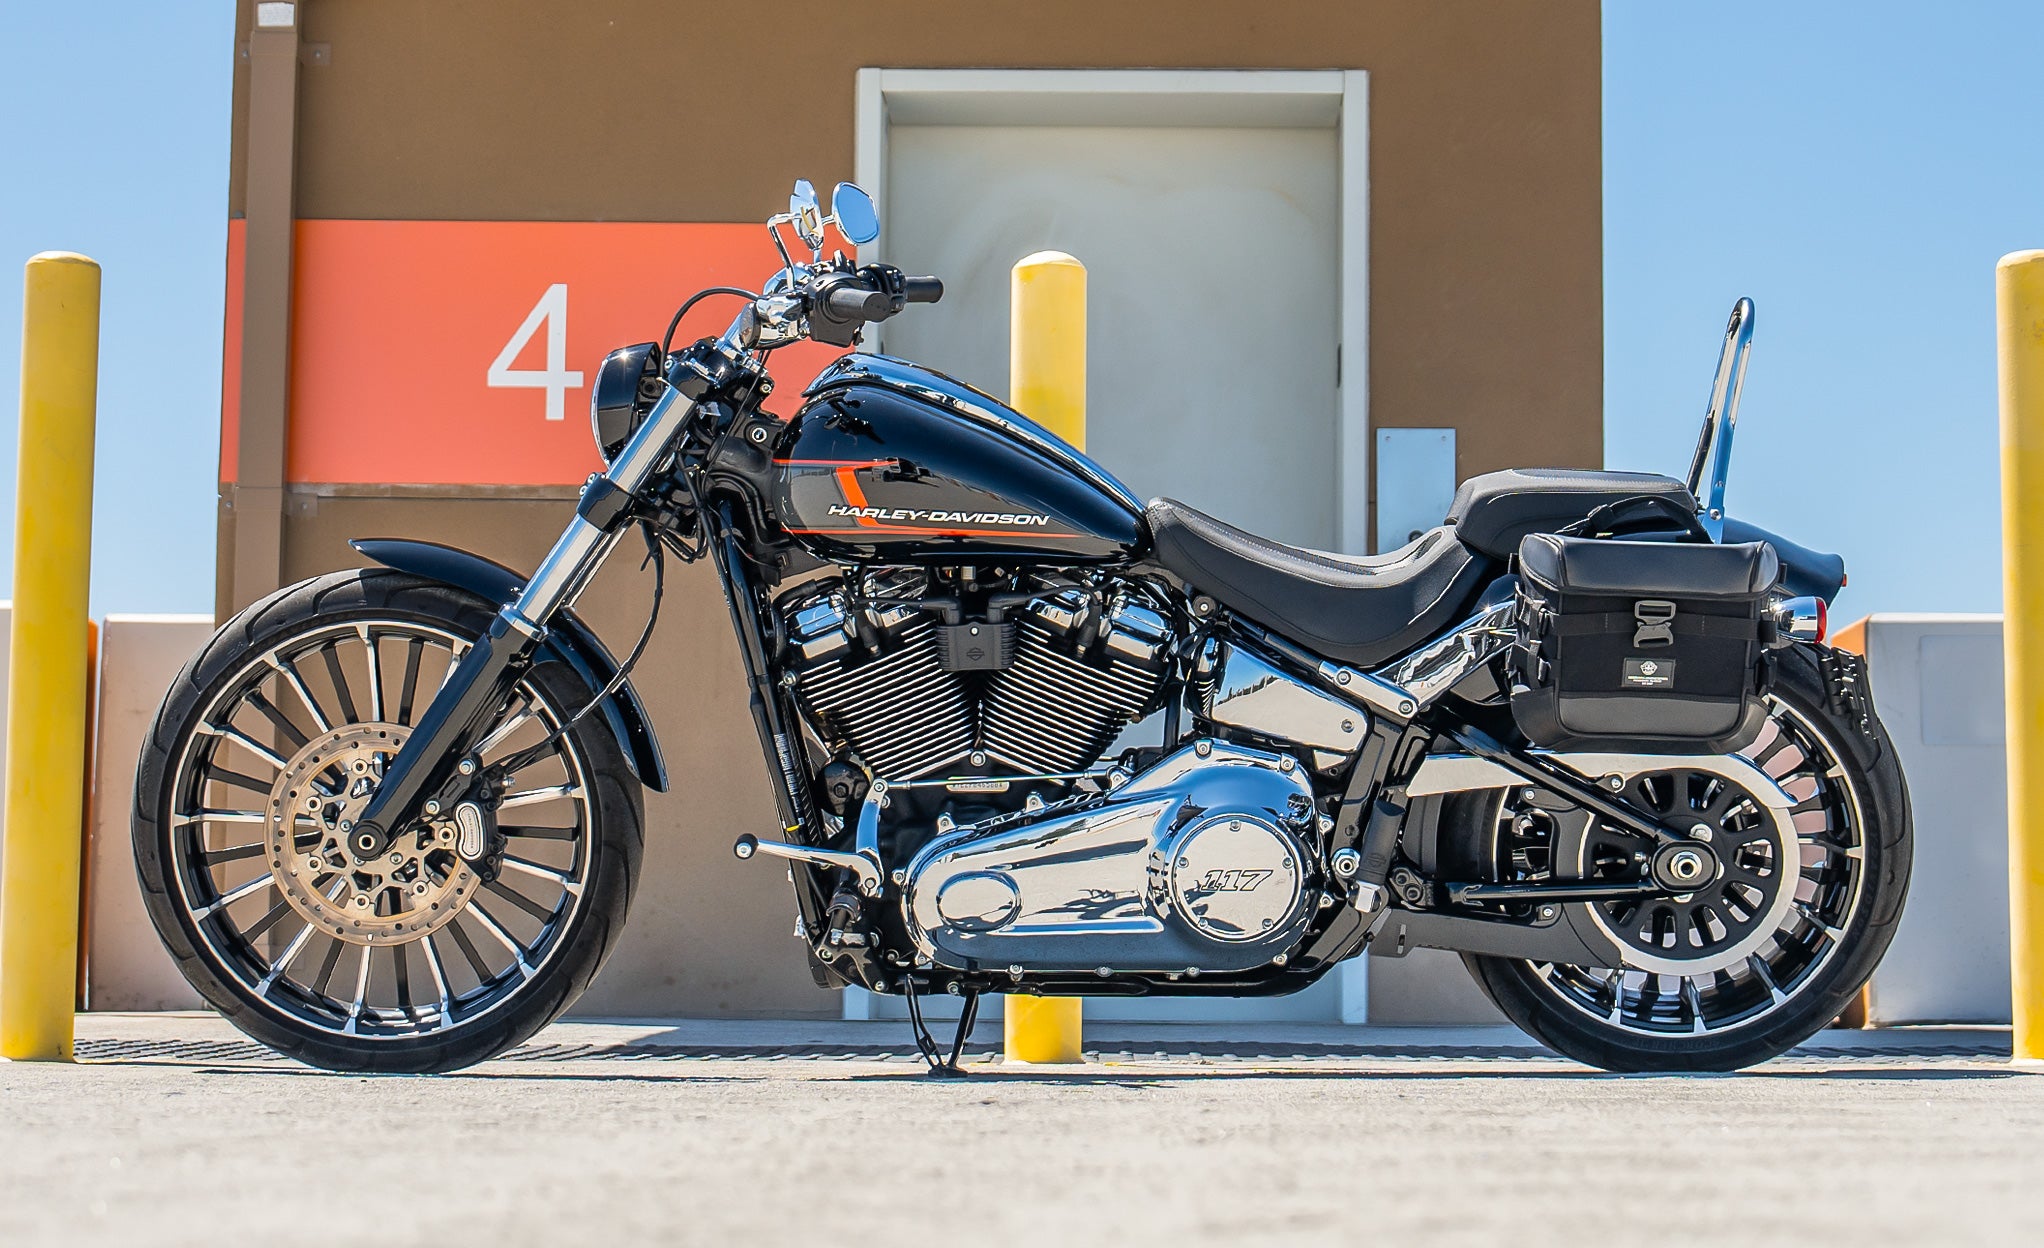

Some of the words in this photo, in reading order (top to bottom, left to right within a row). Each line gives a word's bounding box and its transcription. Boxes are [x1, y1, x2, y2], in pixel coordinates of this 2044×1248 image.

[487, 283, 584, 420] 4
[828, 504, 1050, 527] HARLEY-DAVIDSON
[1200, 869, 1274, 892] 117
